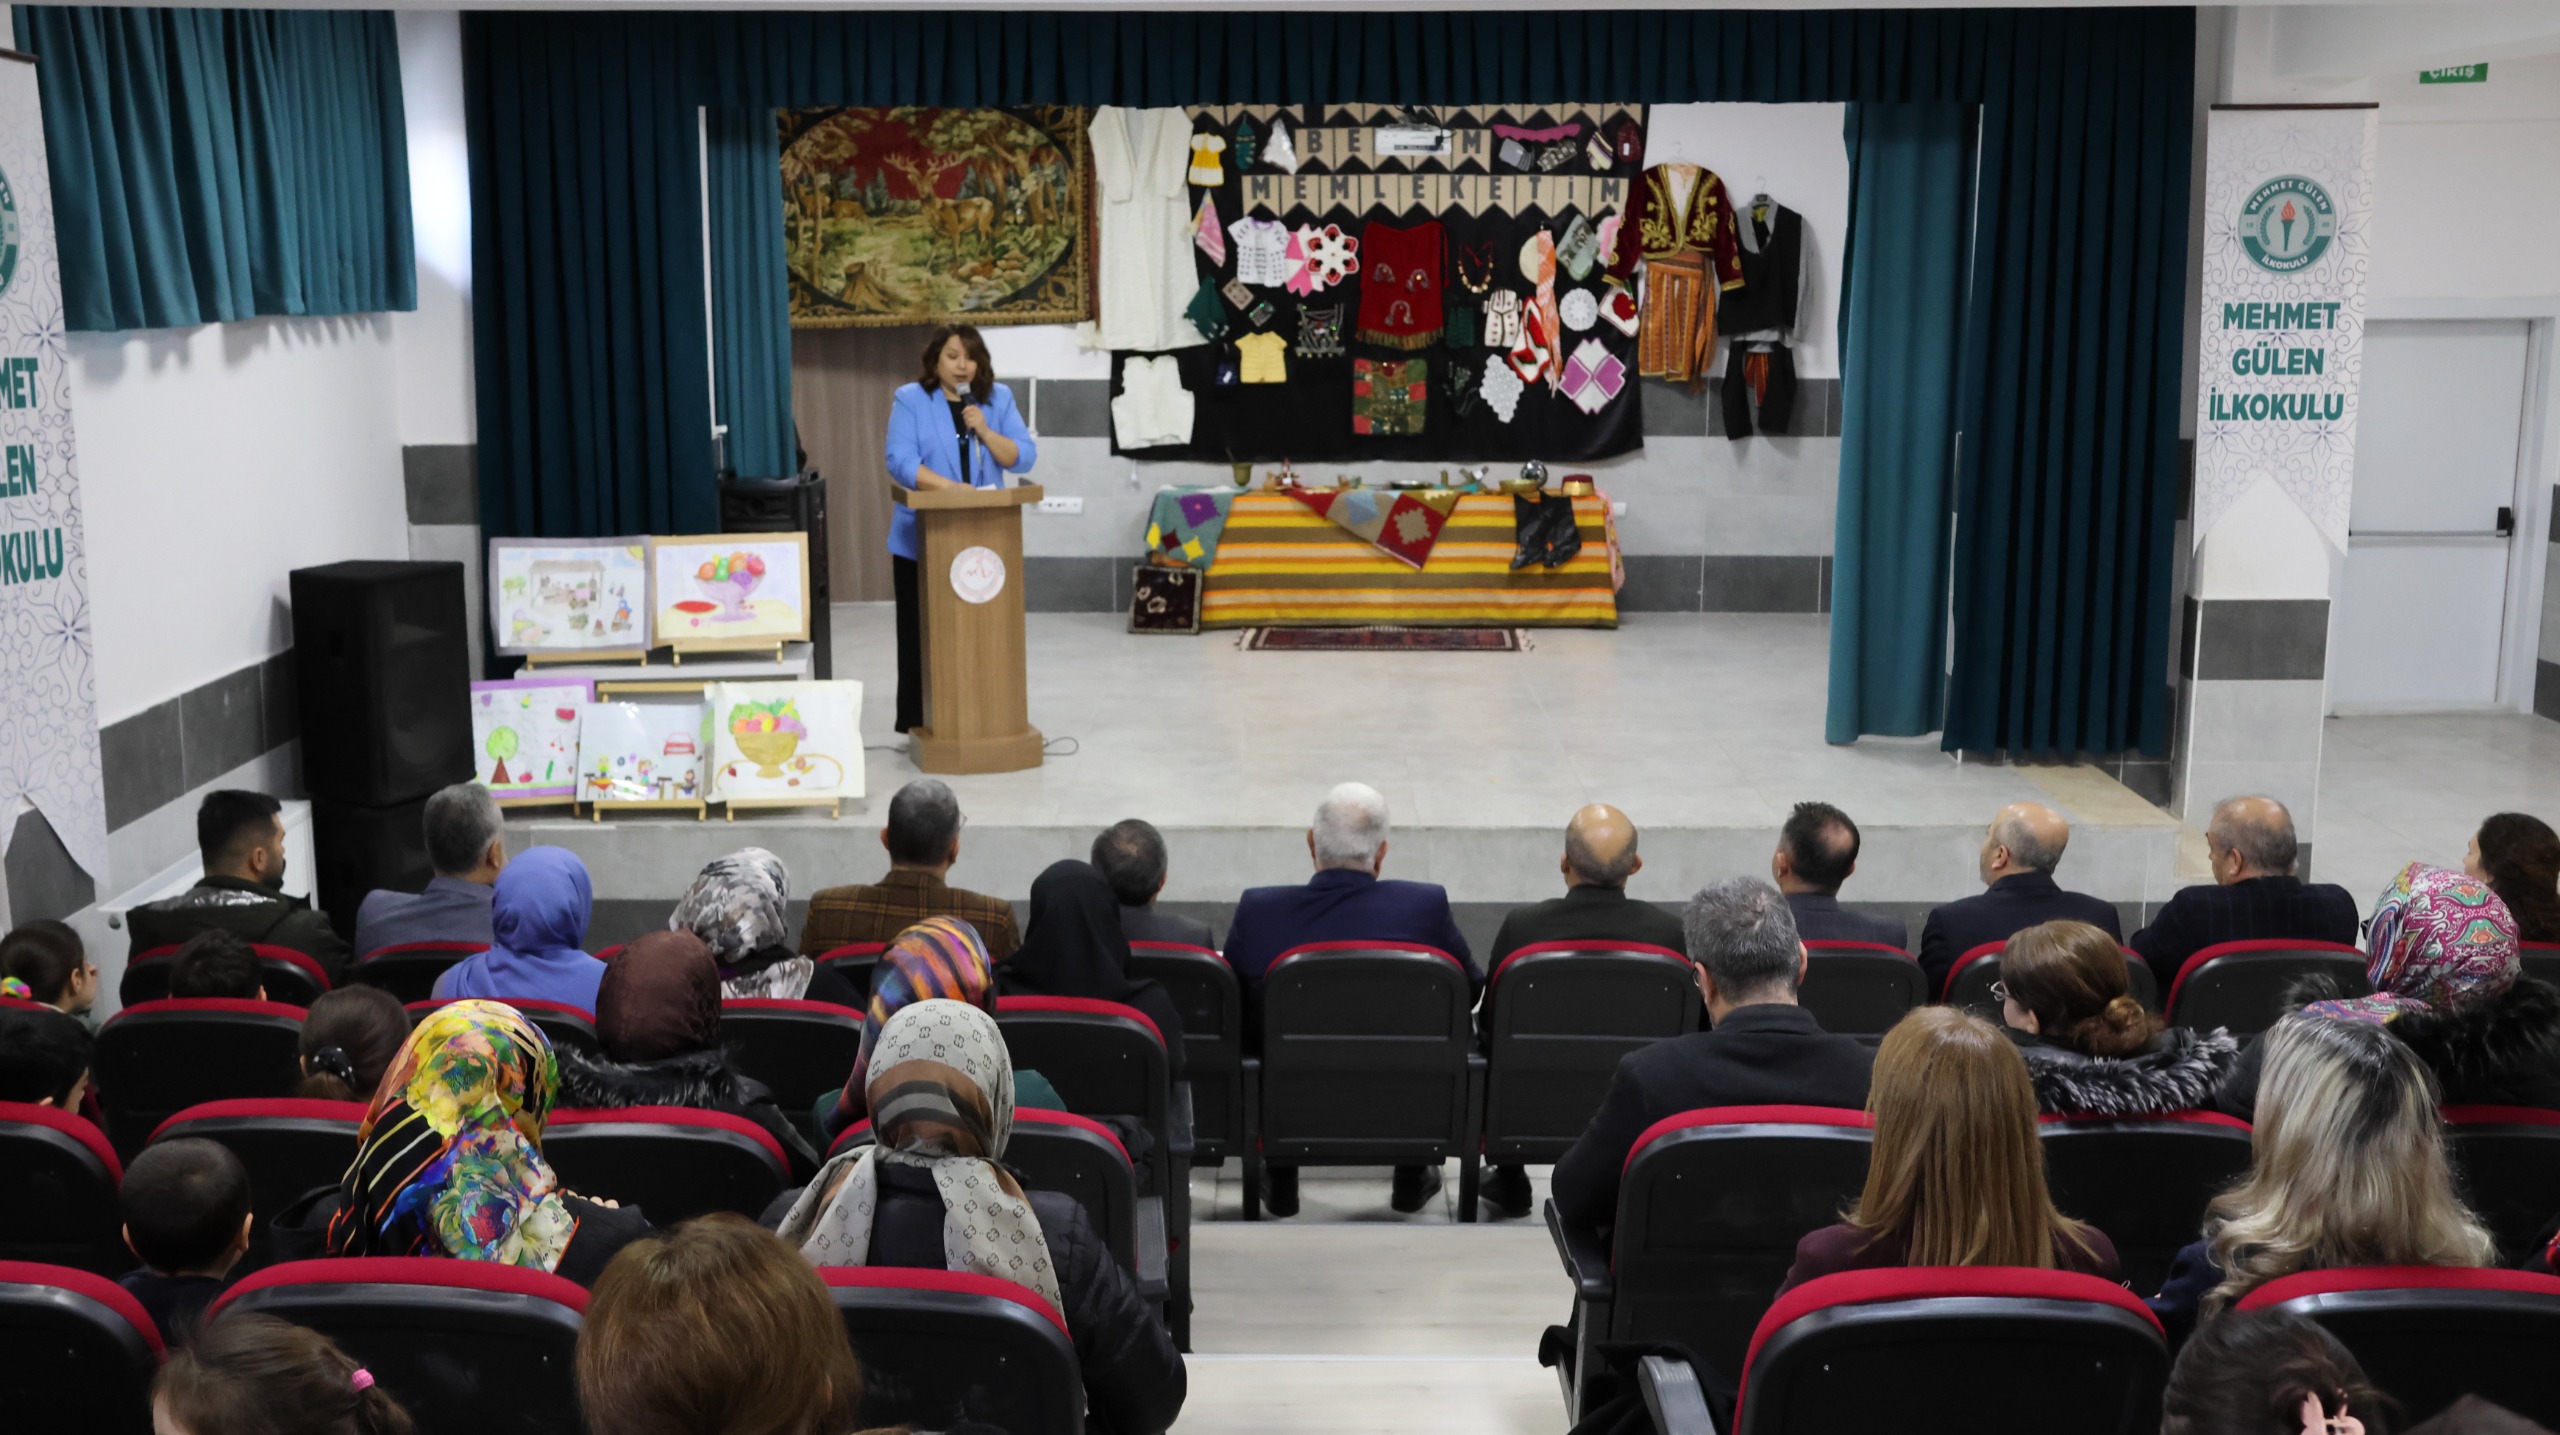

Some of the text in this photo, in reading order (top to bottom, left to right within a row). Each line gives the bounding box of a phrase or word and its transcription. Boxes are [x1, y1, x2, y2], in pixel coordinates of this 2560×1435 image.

[1307, 127, 1482, 154] BEM
[1251, 174, 1620, 203] MEMLEKETİM
[2249, 180, 2329, 211] MEHMET GÜLEN
[2261, 253, 2309, 270] İLKOKULU
[2223, 302, 2341, 330] MEHMET
[2232, 341, 2325, 376] GÜLEN
[2209, 387, 2344, 421] İLKOKULU
